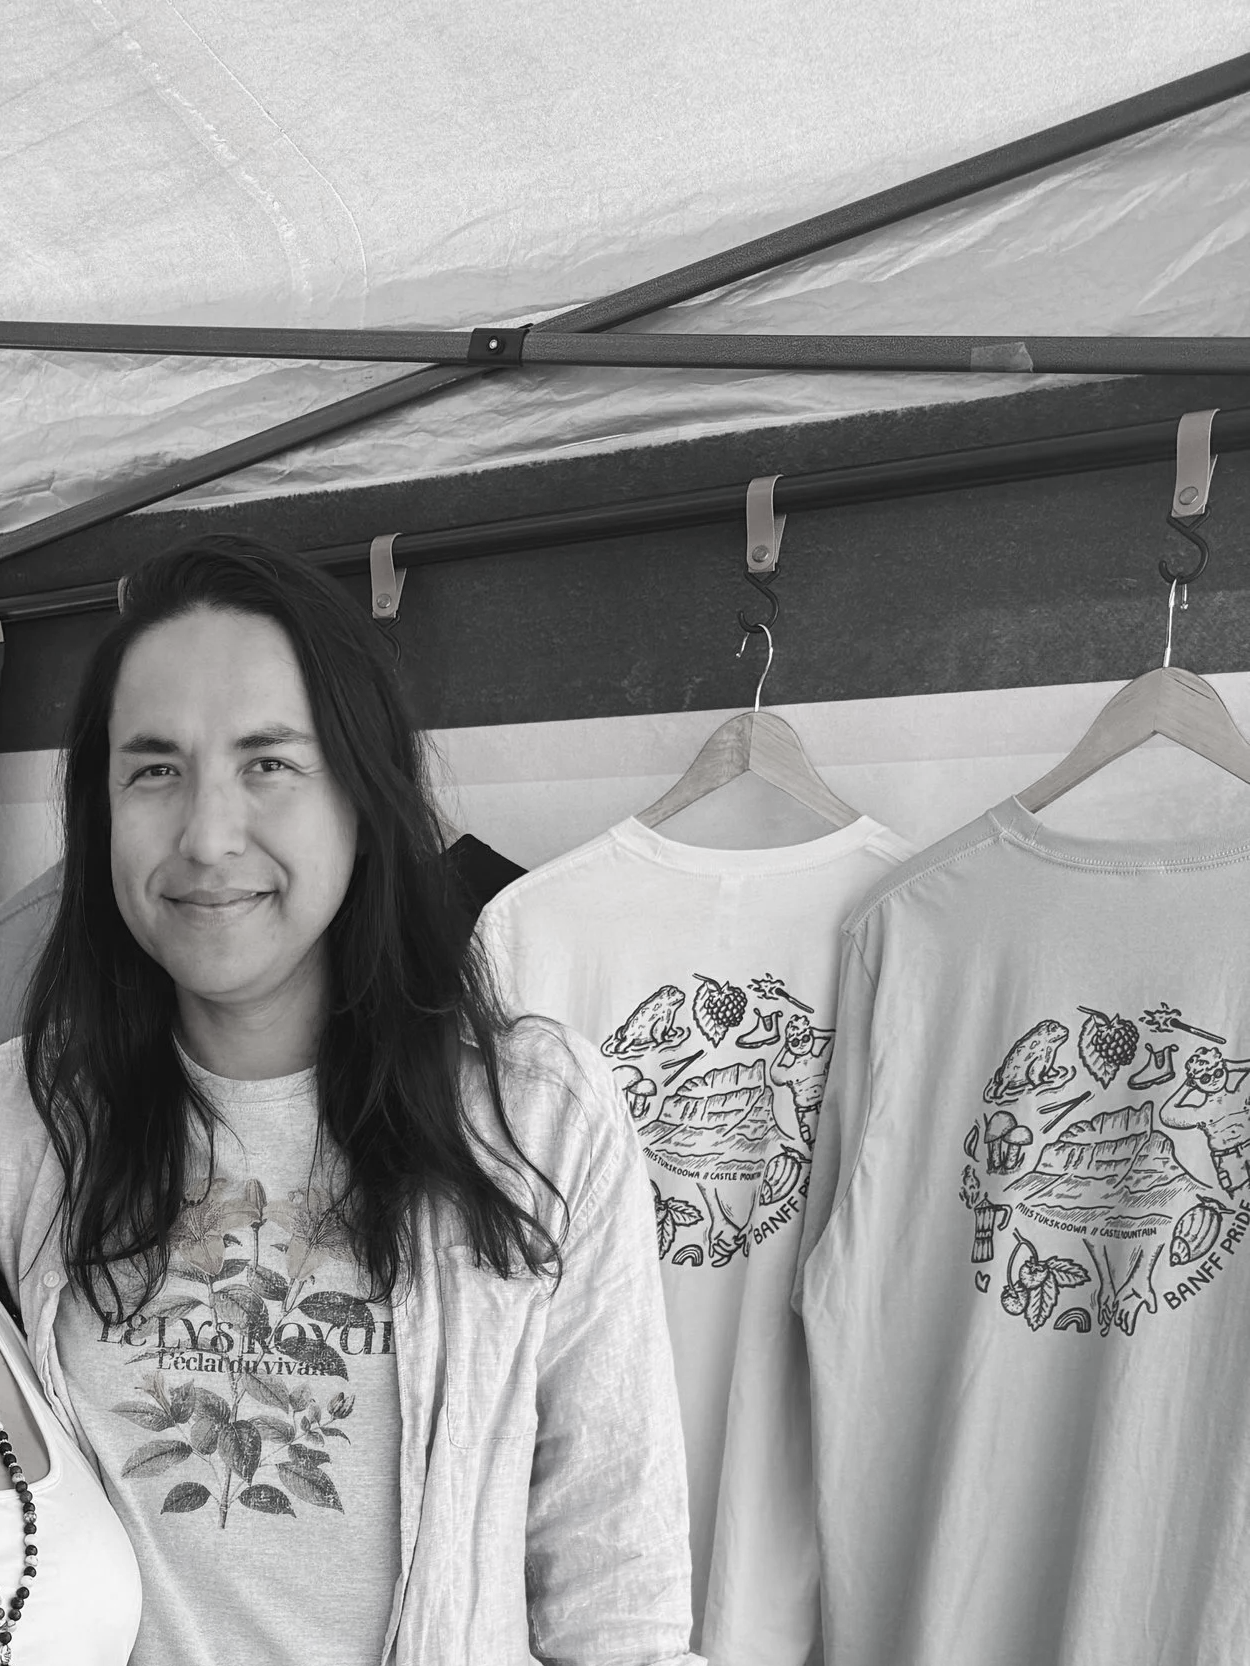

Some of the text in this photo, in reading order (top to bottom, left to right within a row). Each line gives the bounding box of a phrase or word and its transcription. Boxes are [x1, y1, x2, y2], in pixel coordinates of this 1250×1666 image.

[710, 1171, 737, 1181] CASTLE
[753, 1196, 800, 1245] BANFF
[1163, 1252, 1223, 1310] BANFF
